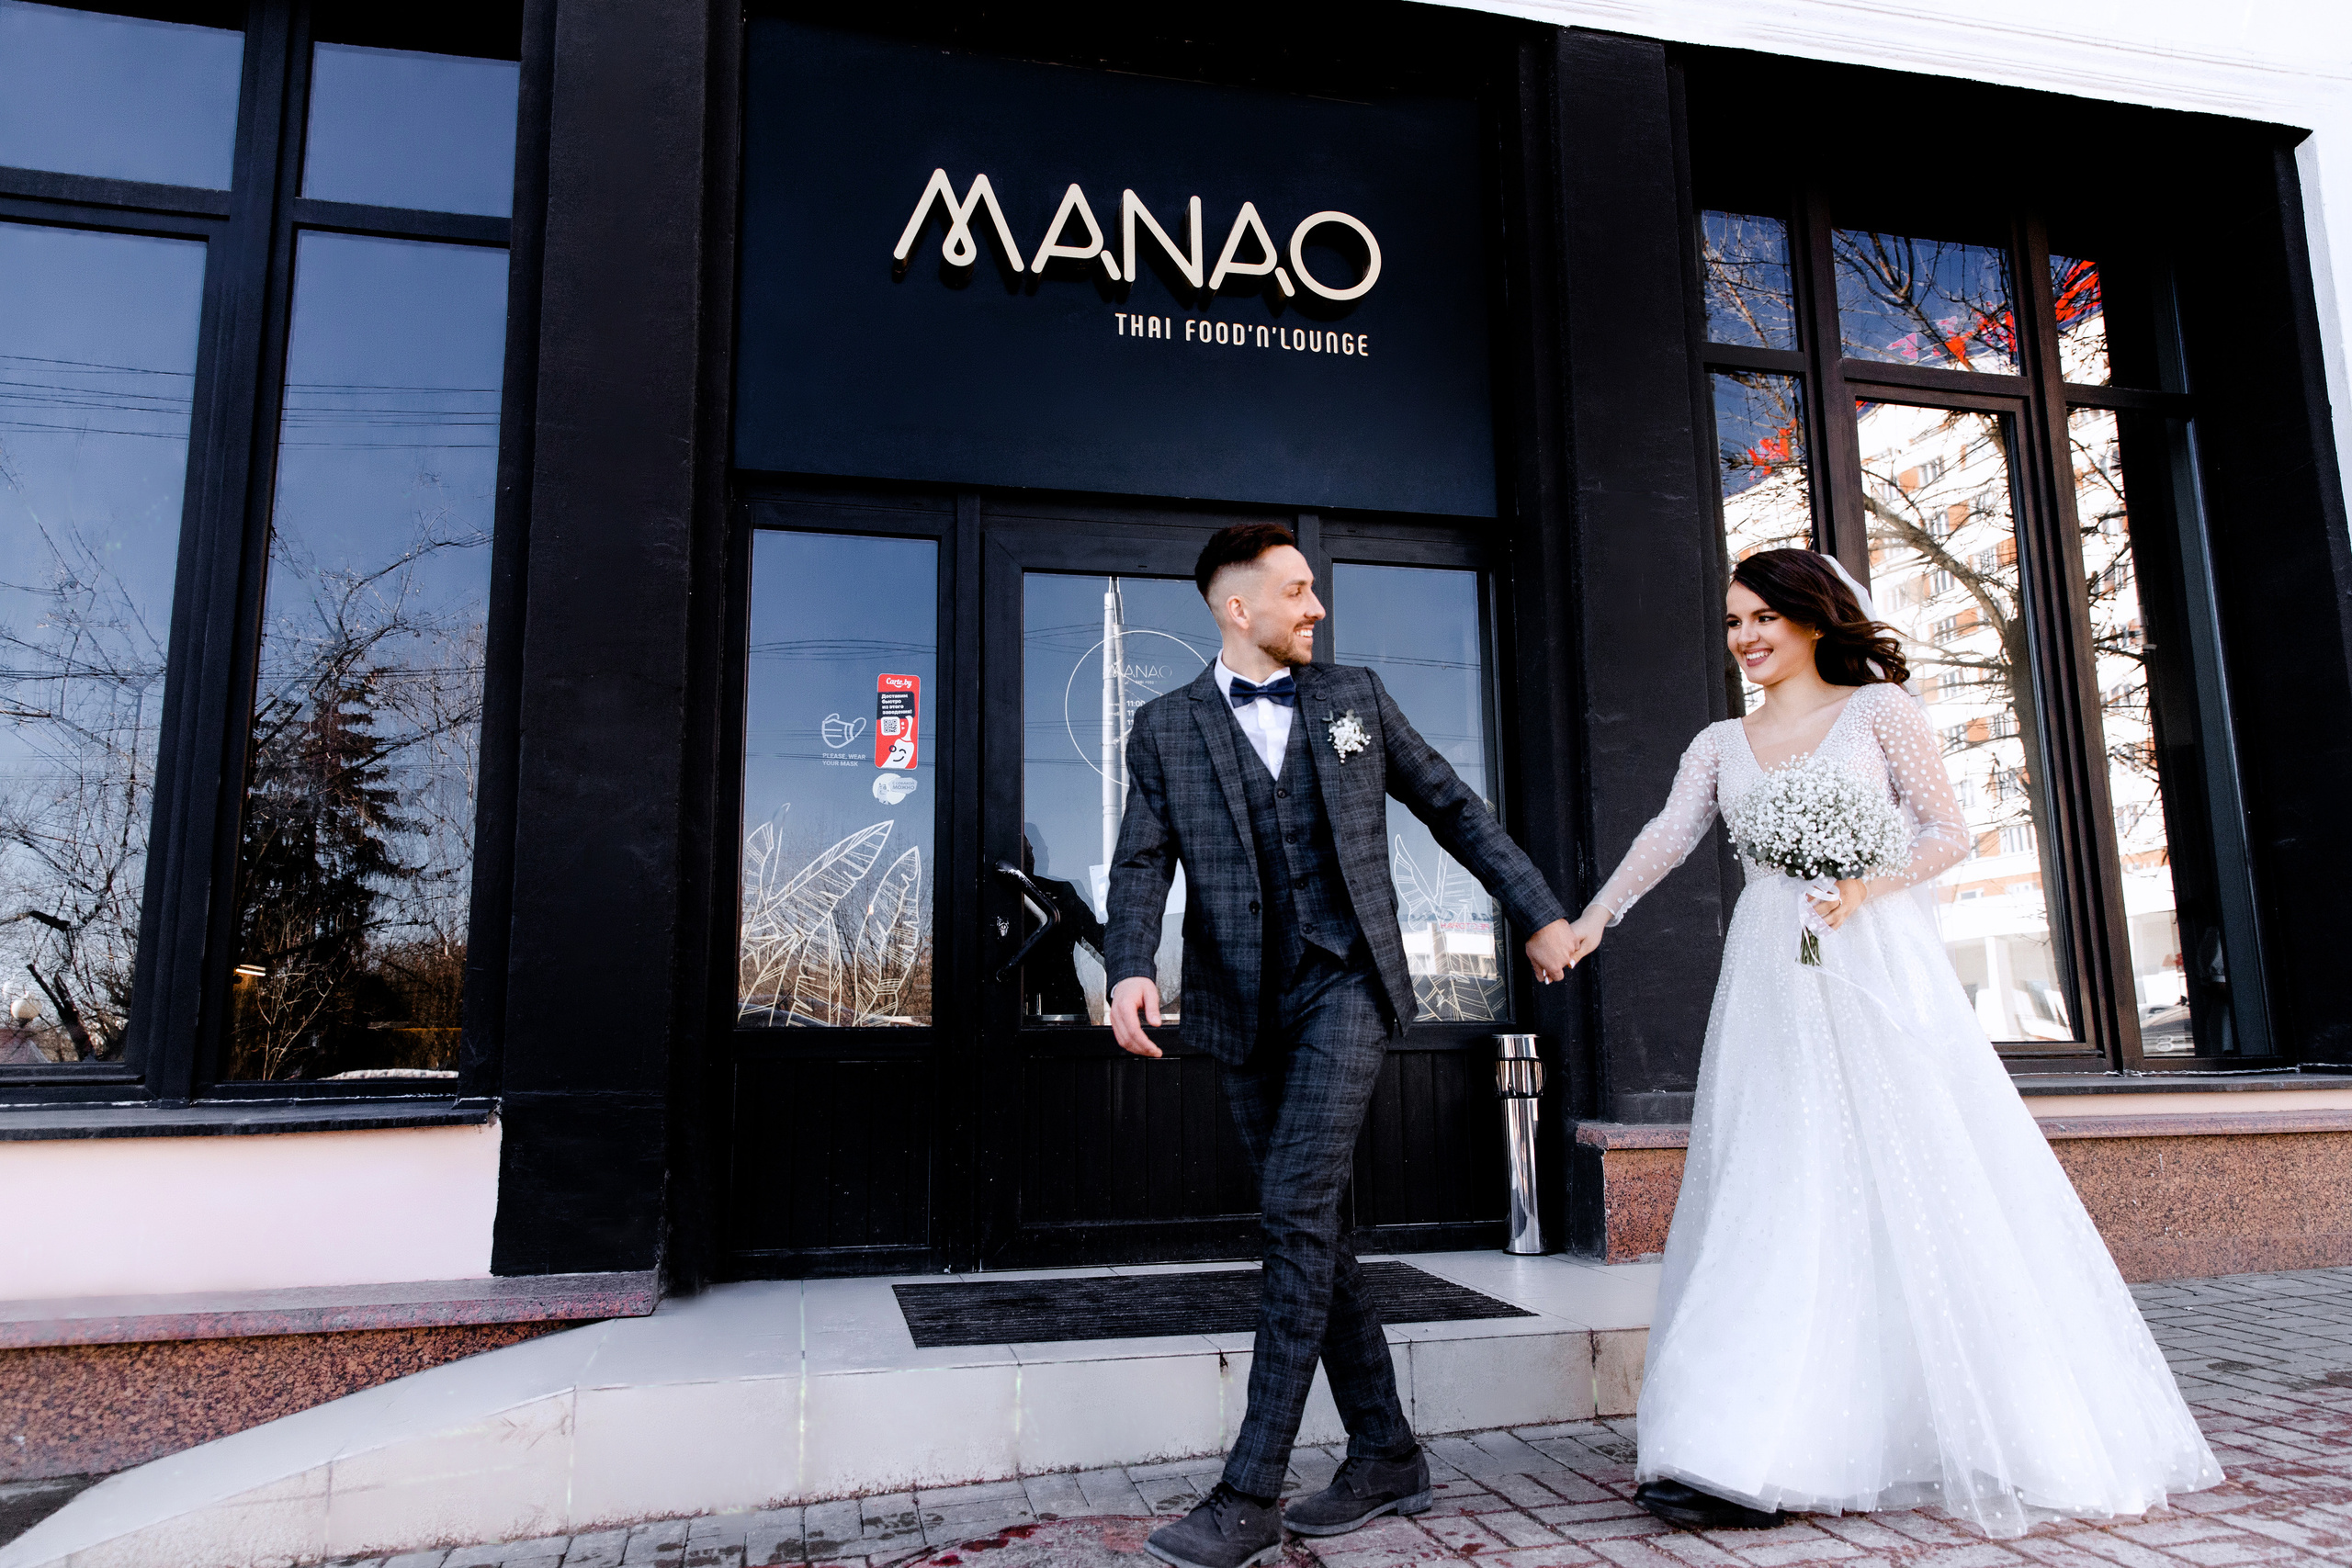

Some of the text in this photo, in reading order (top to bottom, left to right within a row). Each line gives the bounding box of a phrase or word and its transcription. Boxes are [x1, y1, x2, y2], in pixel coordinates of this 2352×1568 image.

[893, 168, 1381, 300] MANAO
[1114, 312, 1171, 340] THAI
[1108, 664, 1172, 678] MANAO
